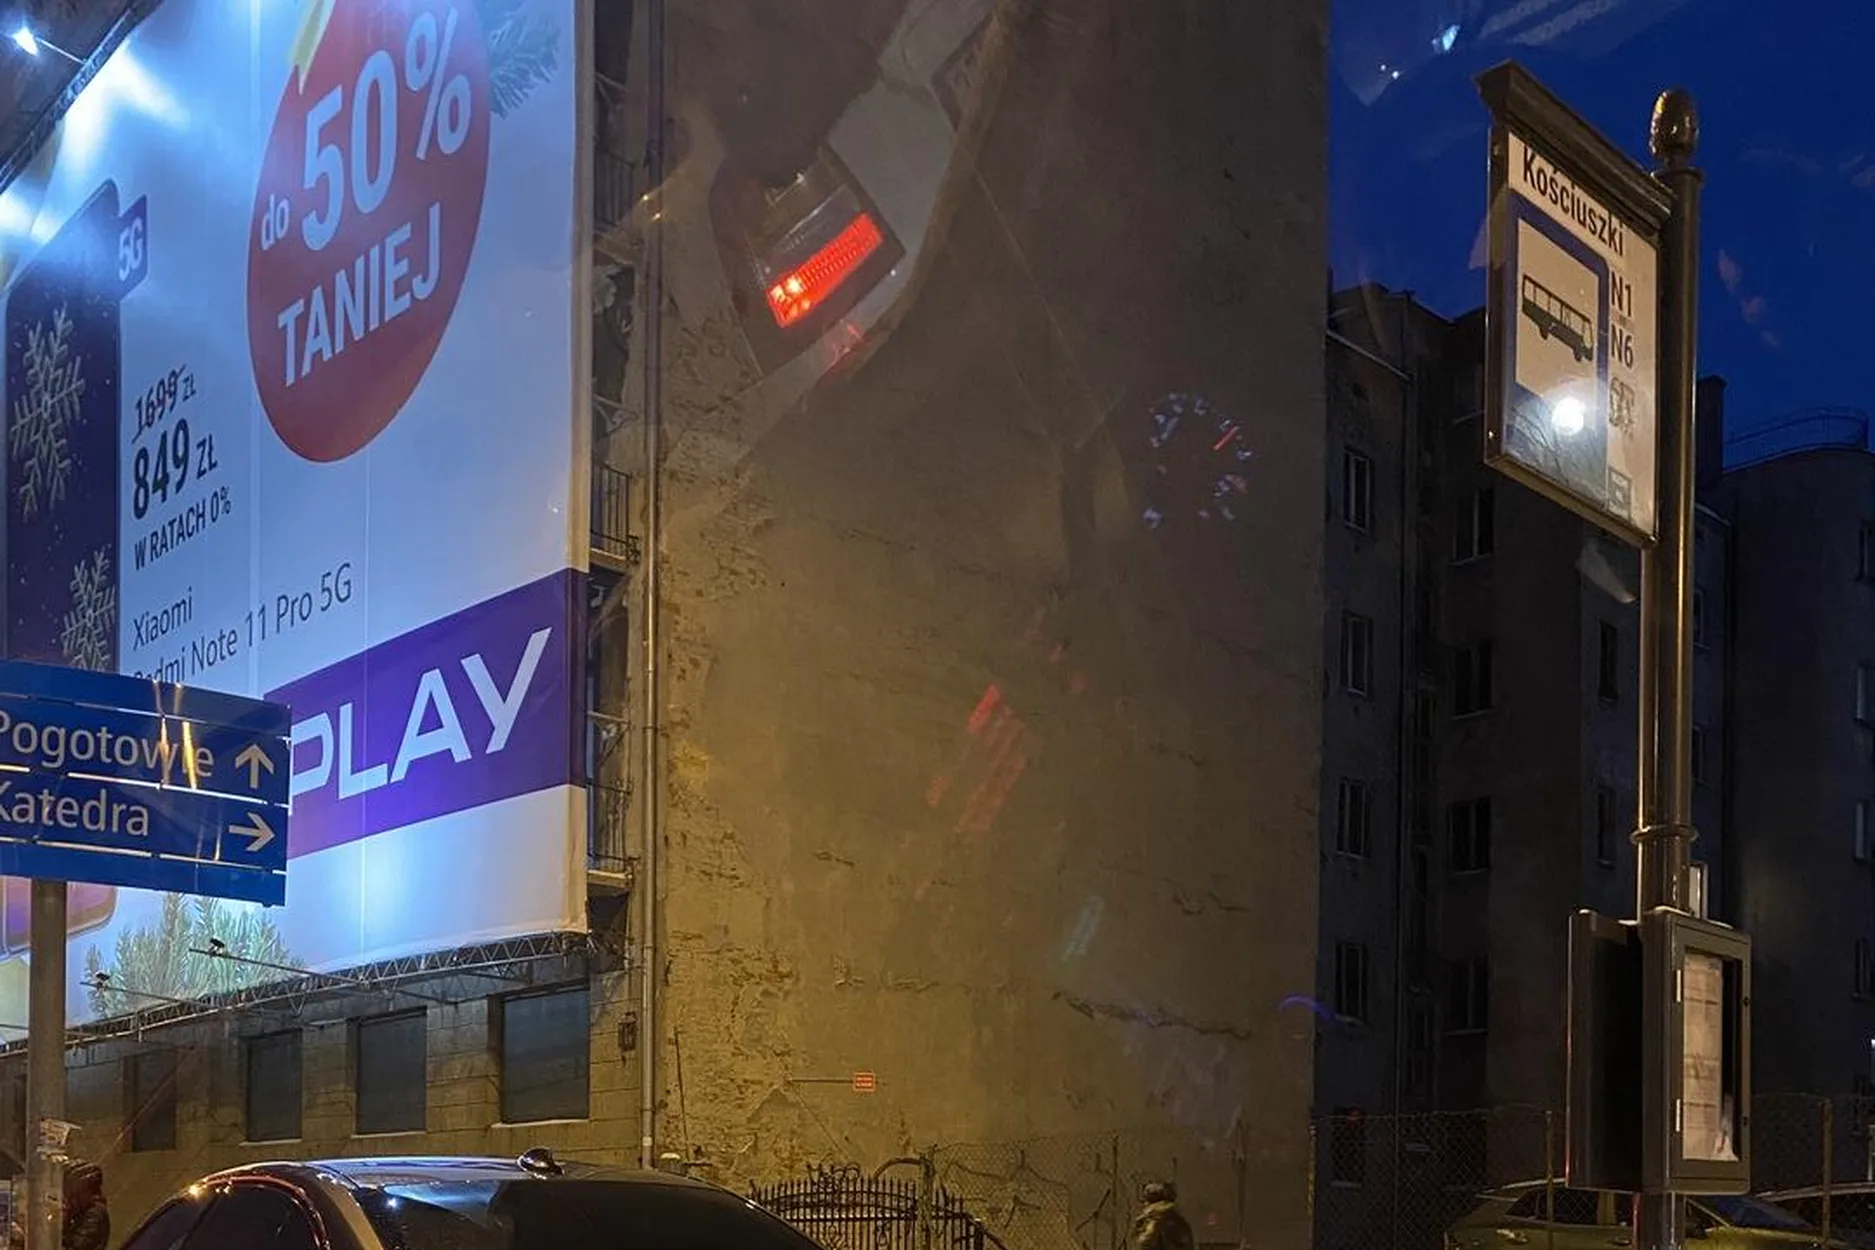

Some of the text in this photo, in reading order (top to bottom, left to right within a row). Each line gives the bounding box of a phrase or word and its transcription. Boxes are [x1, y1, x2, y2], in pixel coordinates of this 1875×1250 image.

[261, 7, 472, 251] do 50%
[119, 216, 143, 281] 5G
[1523, 145, 1624, 257] Kościuszki
[277, 202, 441, 388] TANIEJ
[1611, 271, 1633, 318] N1
[1611, 324, 1634, 369] N6
[133, 417, 190, 520] 849
[134, 486, 232, 571] W RATACH 0%
[133, 586, 194, 651] Xiaomi
[134, 562, 352, 684] dmi Note 11 Pro 5G
[291, 626, 552, 800] PLAY
